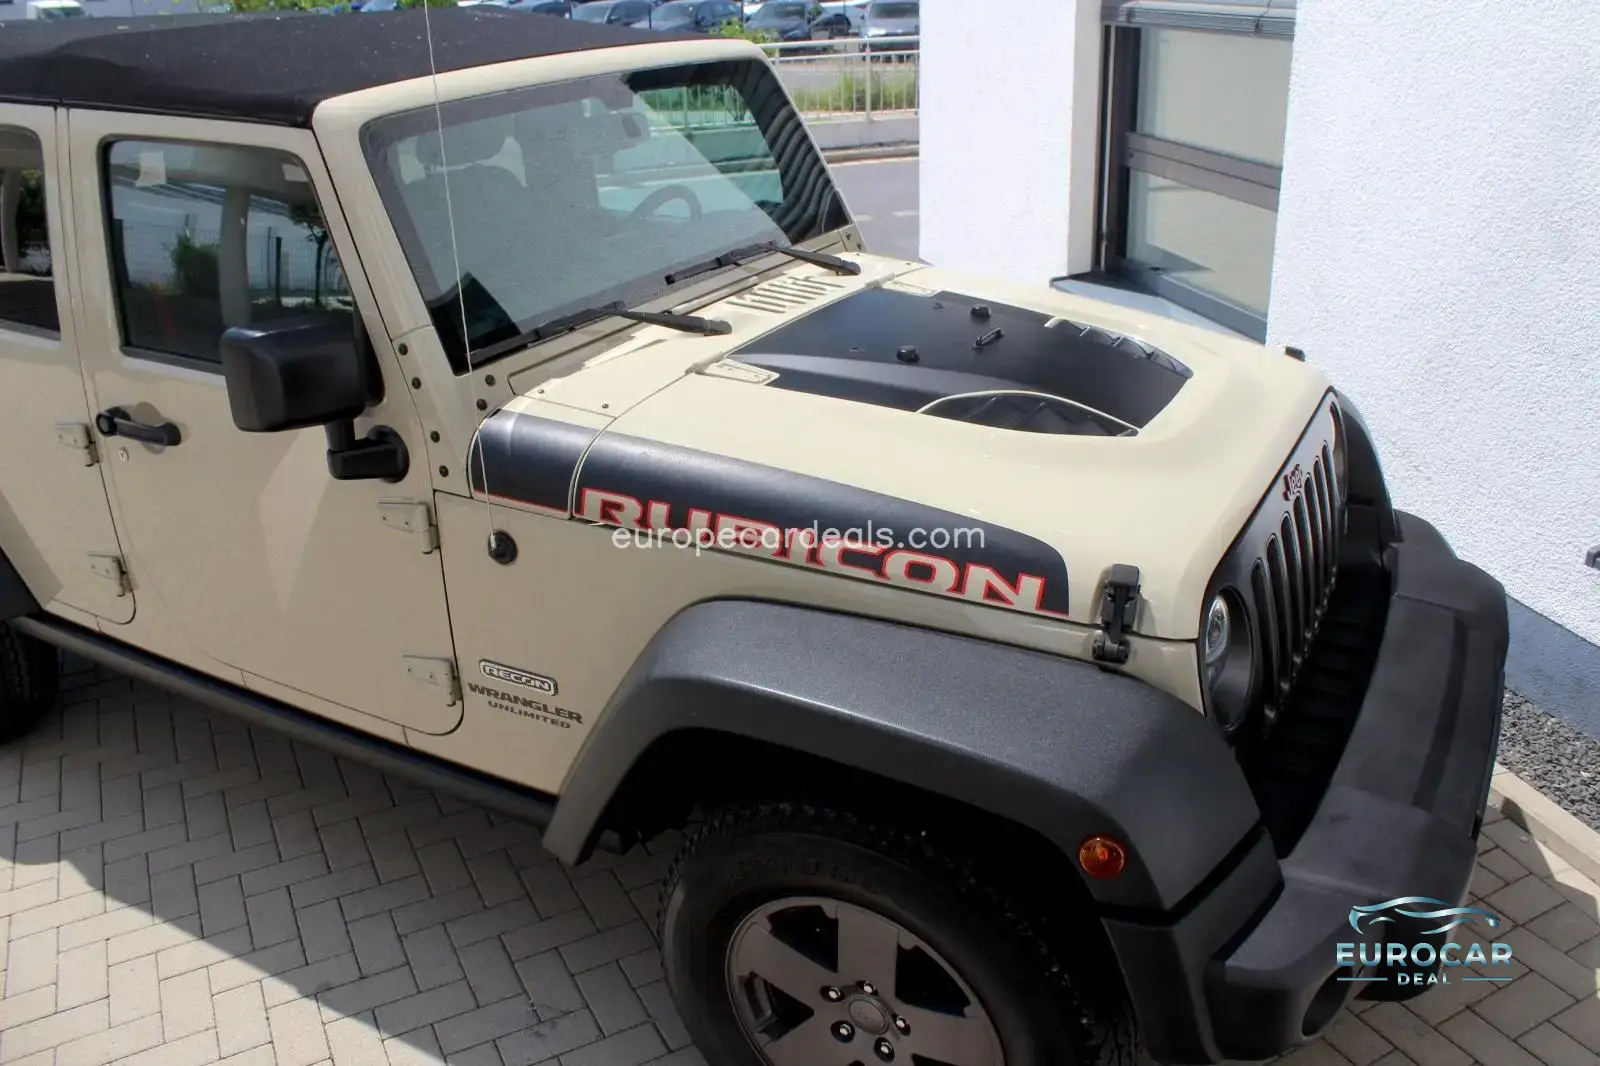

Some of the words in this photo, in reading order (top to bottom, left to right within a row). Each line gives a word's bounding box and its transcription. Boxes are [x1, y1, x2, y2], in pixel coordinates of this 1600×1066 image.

[579, 487, 1047, 612] RUBICON
[483, 664, 552, 692] RECON
[468, 682, 584, 725] WRANGLER
[487, 700, 572, 729] UNLIMITED
